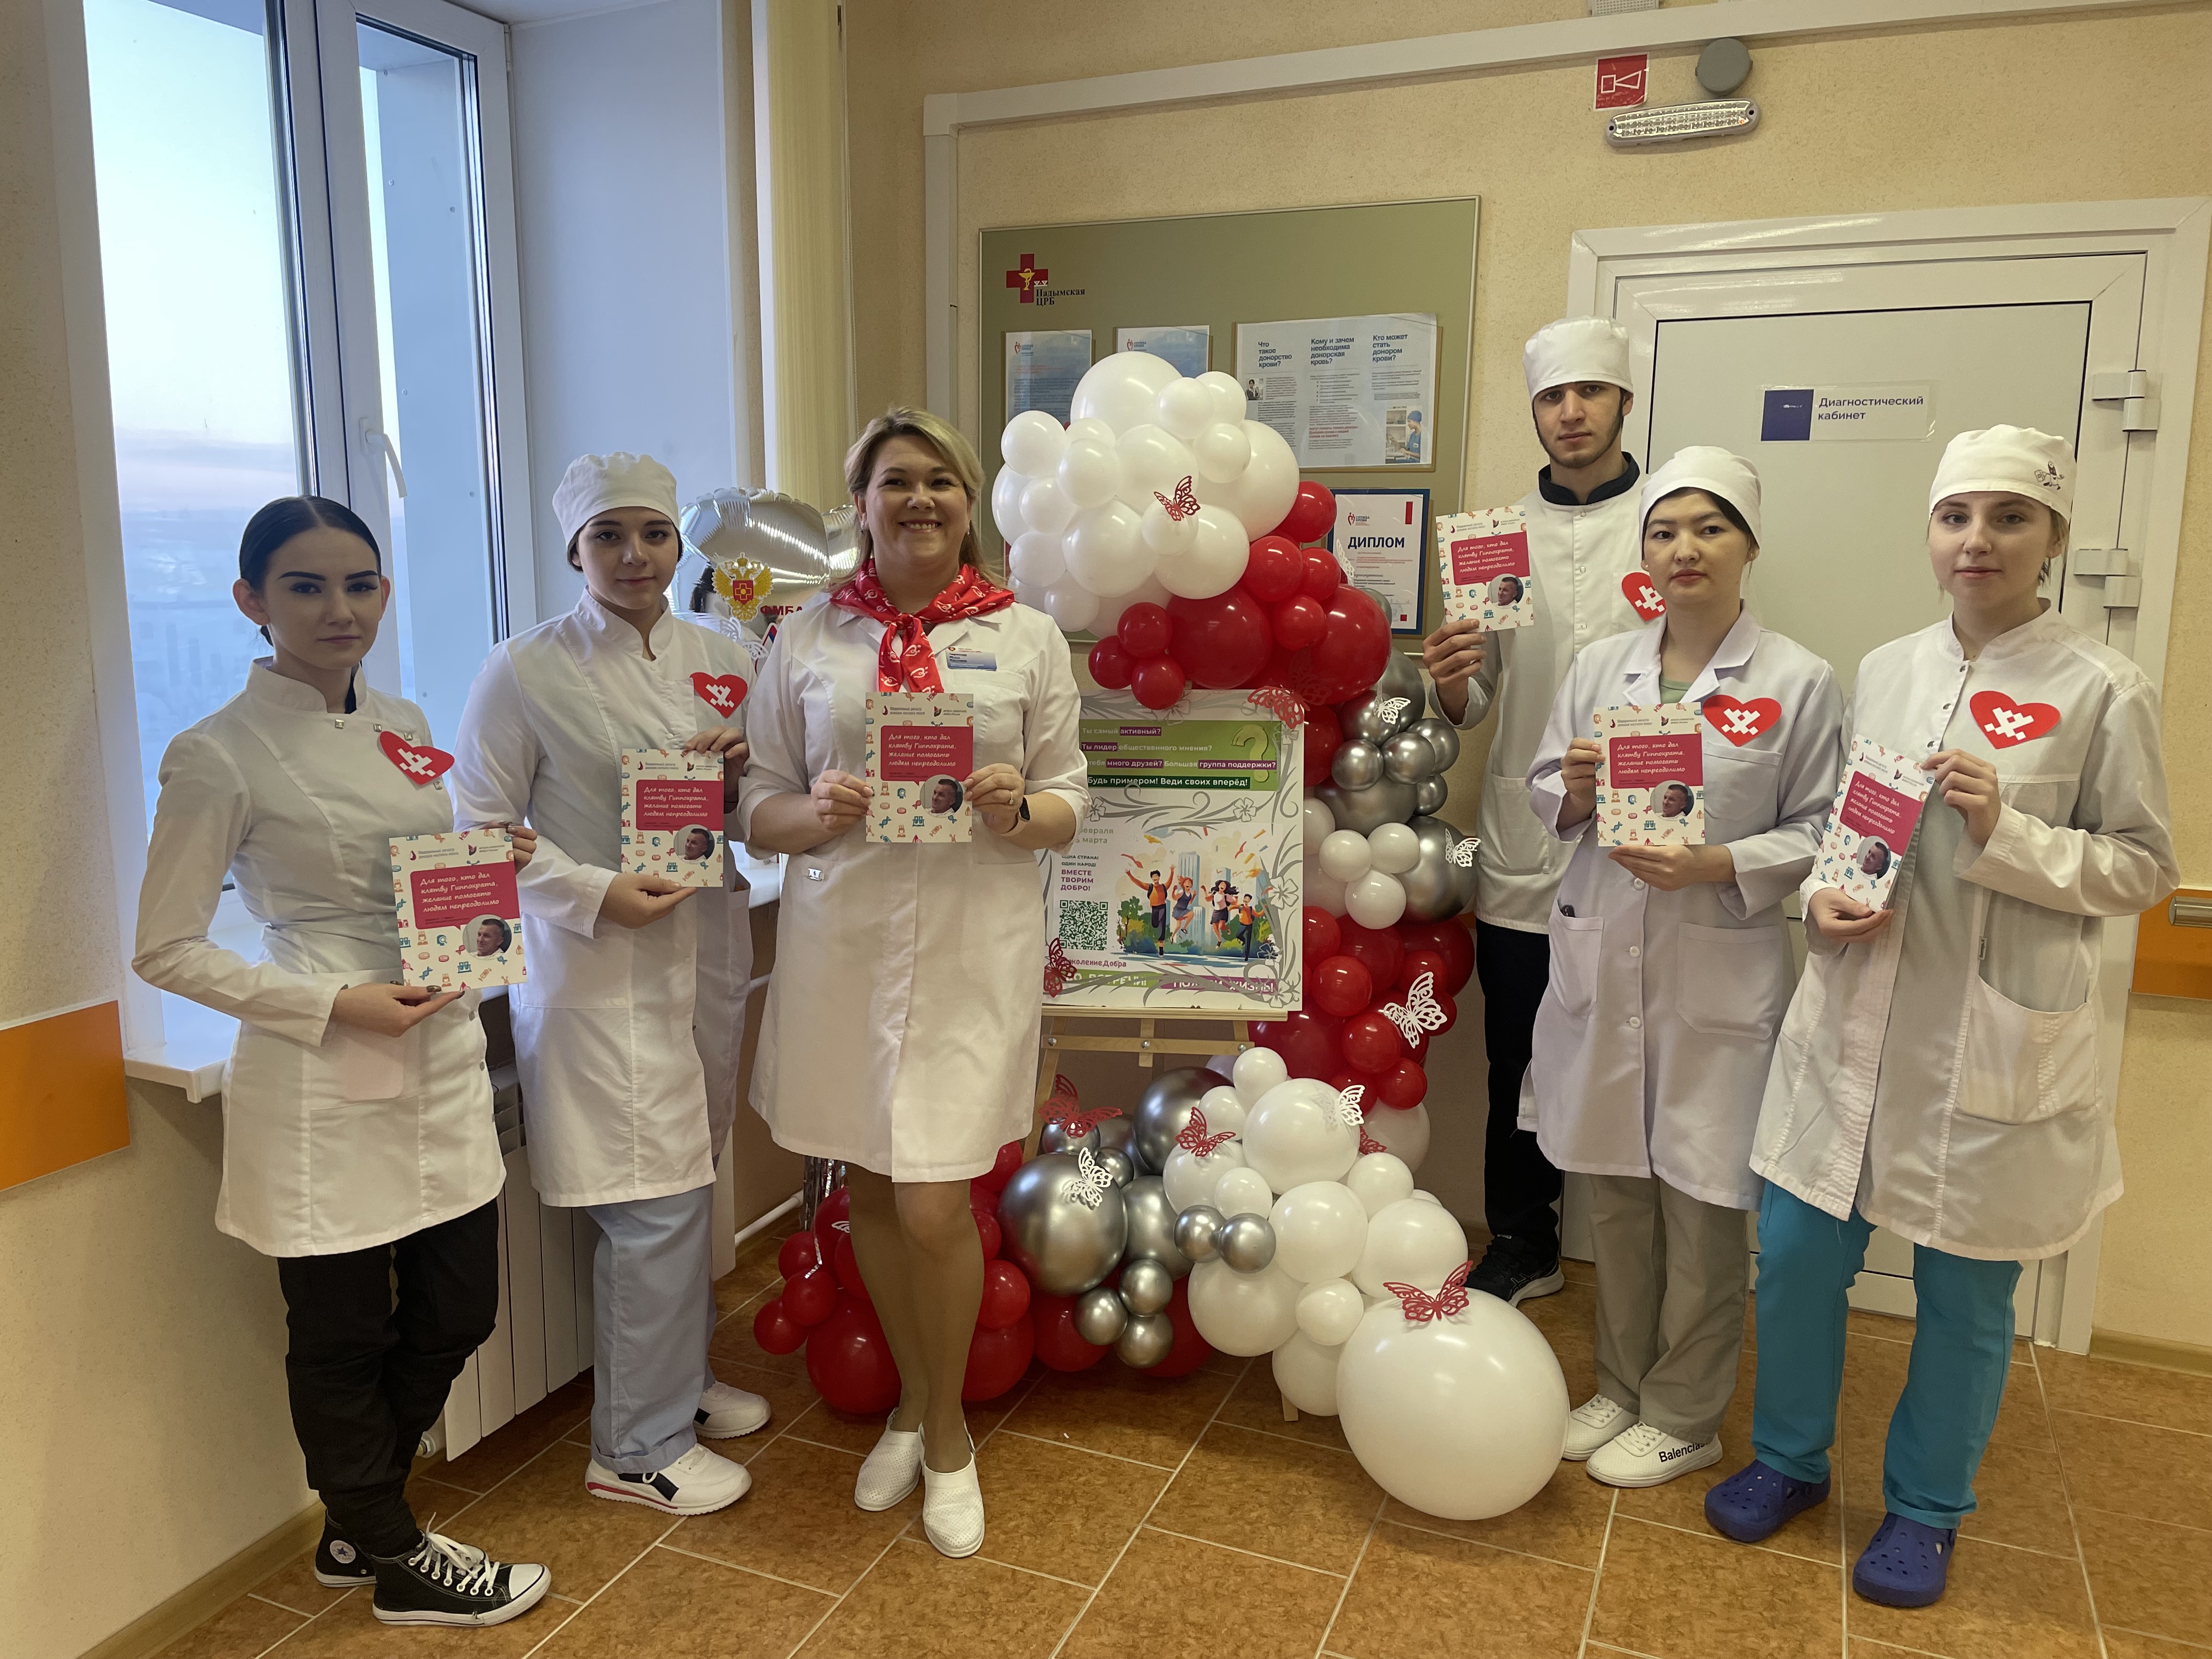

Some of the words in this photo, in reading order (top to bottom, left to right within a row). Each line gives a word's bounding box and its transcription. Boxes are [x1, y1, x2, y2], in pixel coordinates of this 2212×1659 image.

[1036, 297, 1054, 307] ЦРБ
[1819, 396, 1923, 407] Диагностический
[1818, 411, 1865, 420] кабинет
[1348, 537, 1404, 549] ДИПЛОМ
[421, 884, 448, 894] клятву
[423, 904, 447, 912] людям
[450, 900, 499, 910] непреодолимо
[1066, 959, 1126, 968] колениеДобра
